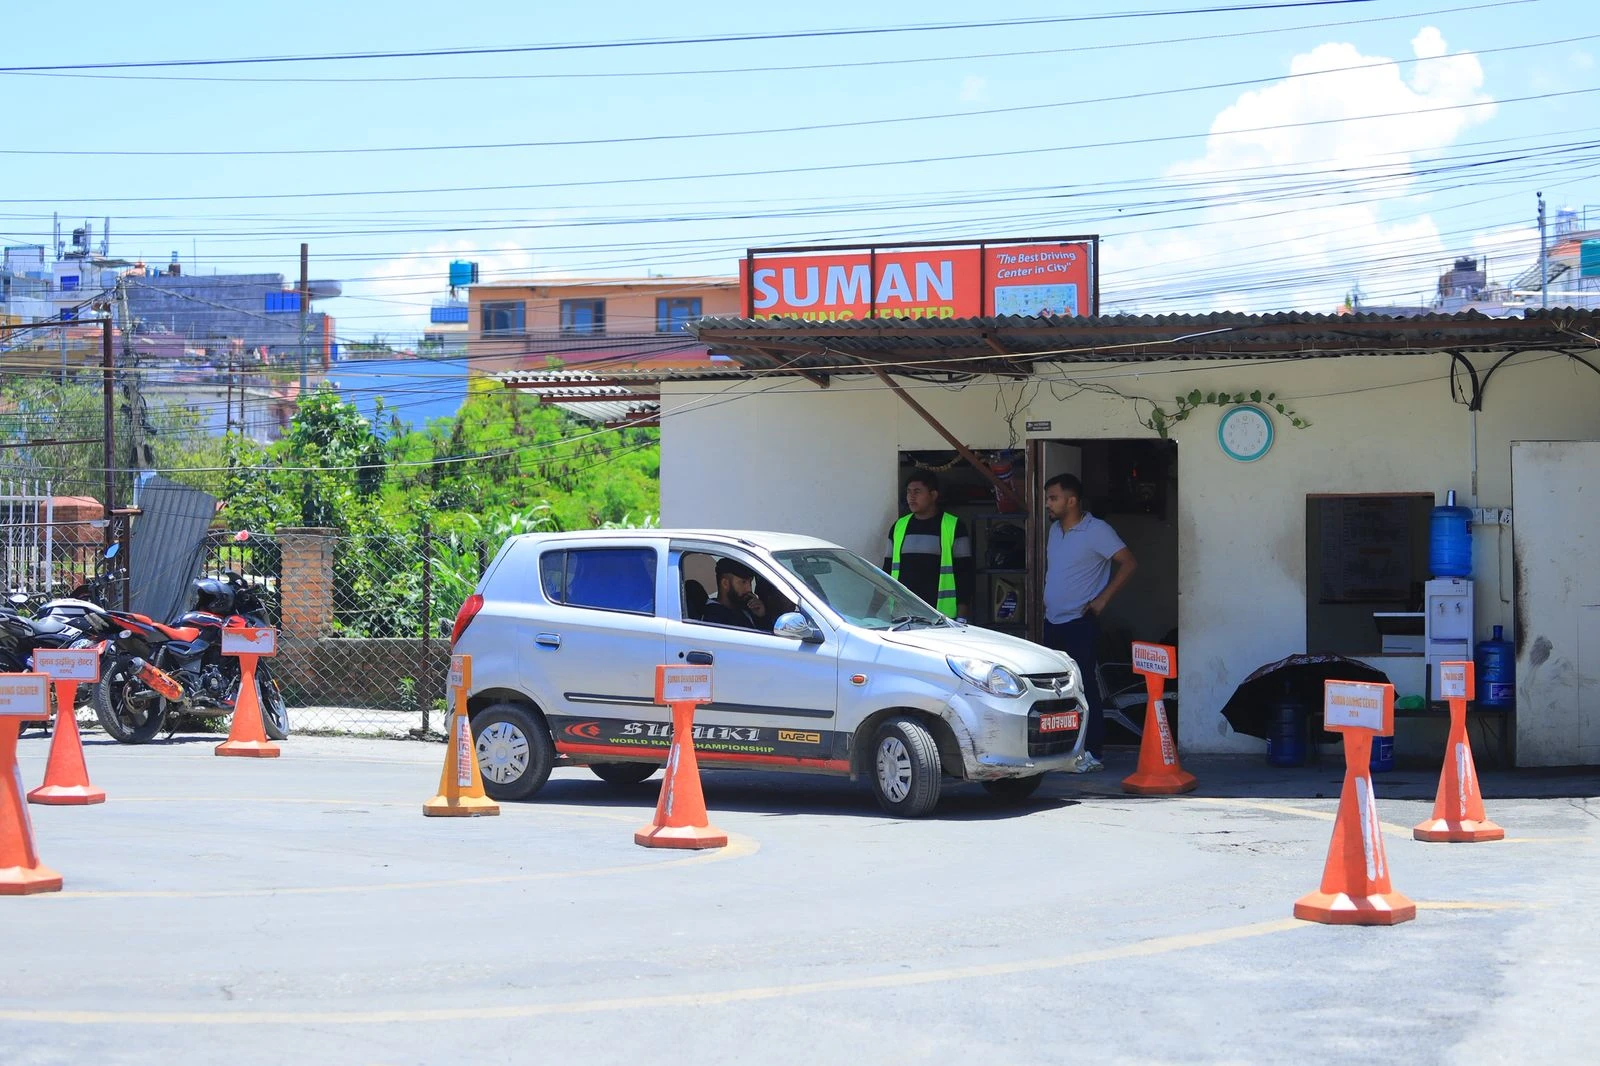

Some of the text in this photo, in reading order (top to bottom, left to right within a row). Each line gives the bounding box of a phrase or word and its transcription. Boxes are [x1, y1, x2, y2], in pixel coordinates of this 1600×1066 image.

[1018, 253, 1039, 263] Best
[1040, 251, 1076, 261] Driving
[997, 267, 1033, 279] Center
[1035, 266, 1045, 274] in
[753, 260, 954, 309] SUMAN
[1135, 659, 1168, 672] WATER TANK
[619, 722, 760, 741] SUUKI
[609, 737, 648, 745] WORLD
[692, 743, 775, 753] HAMPIONSHIP
